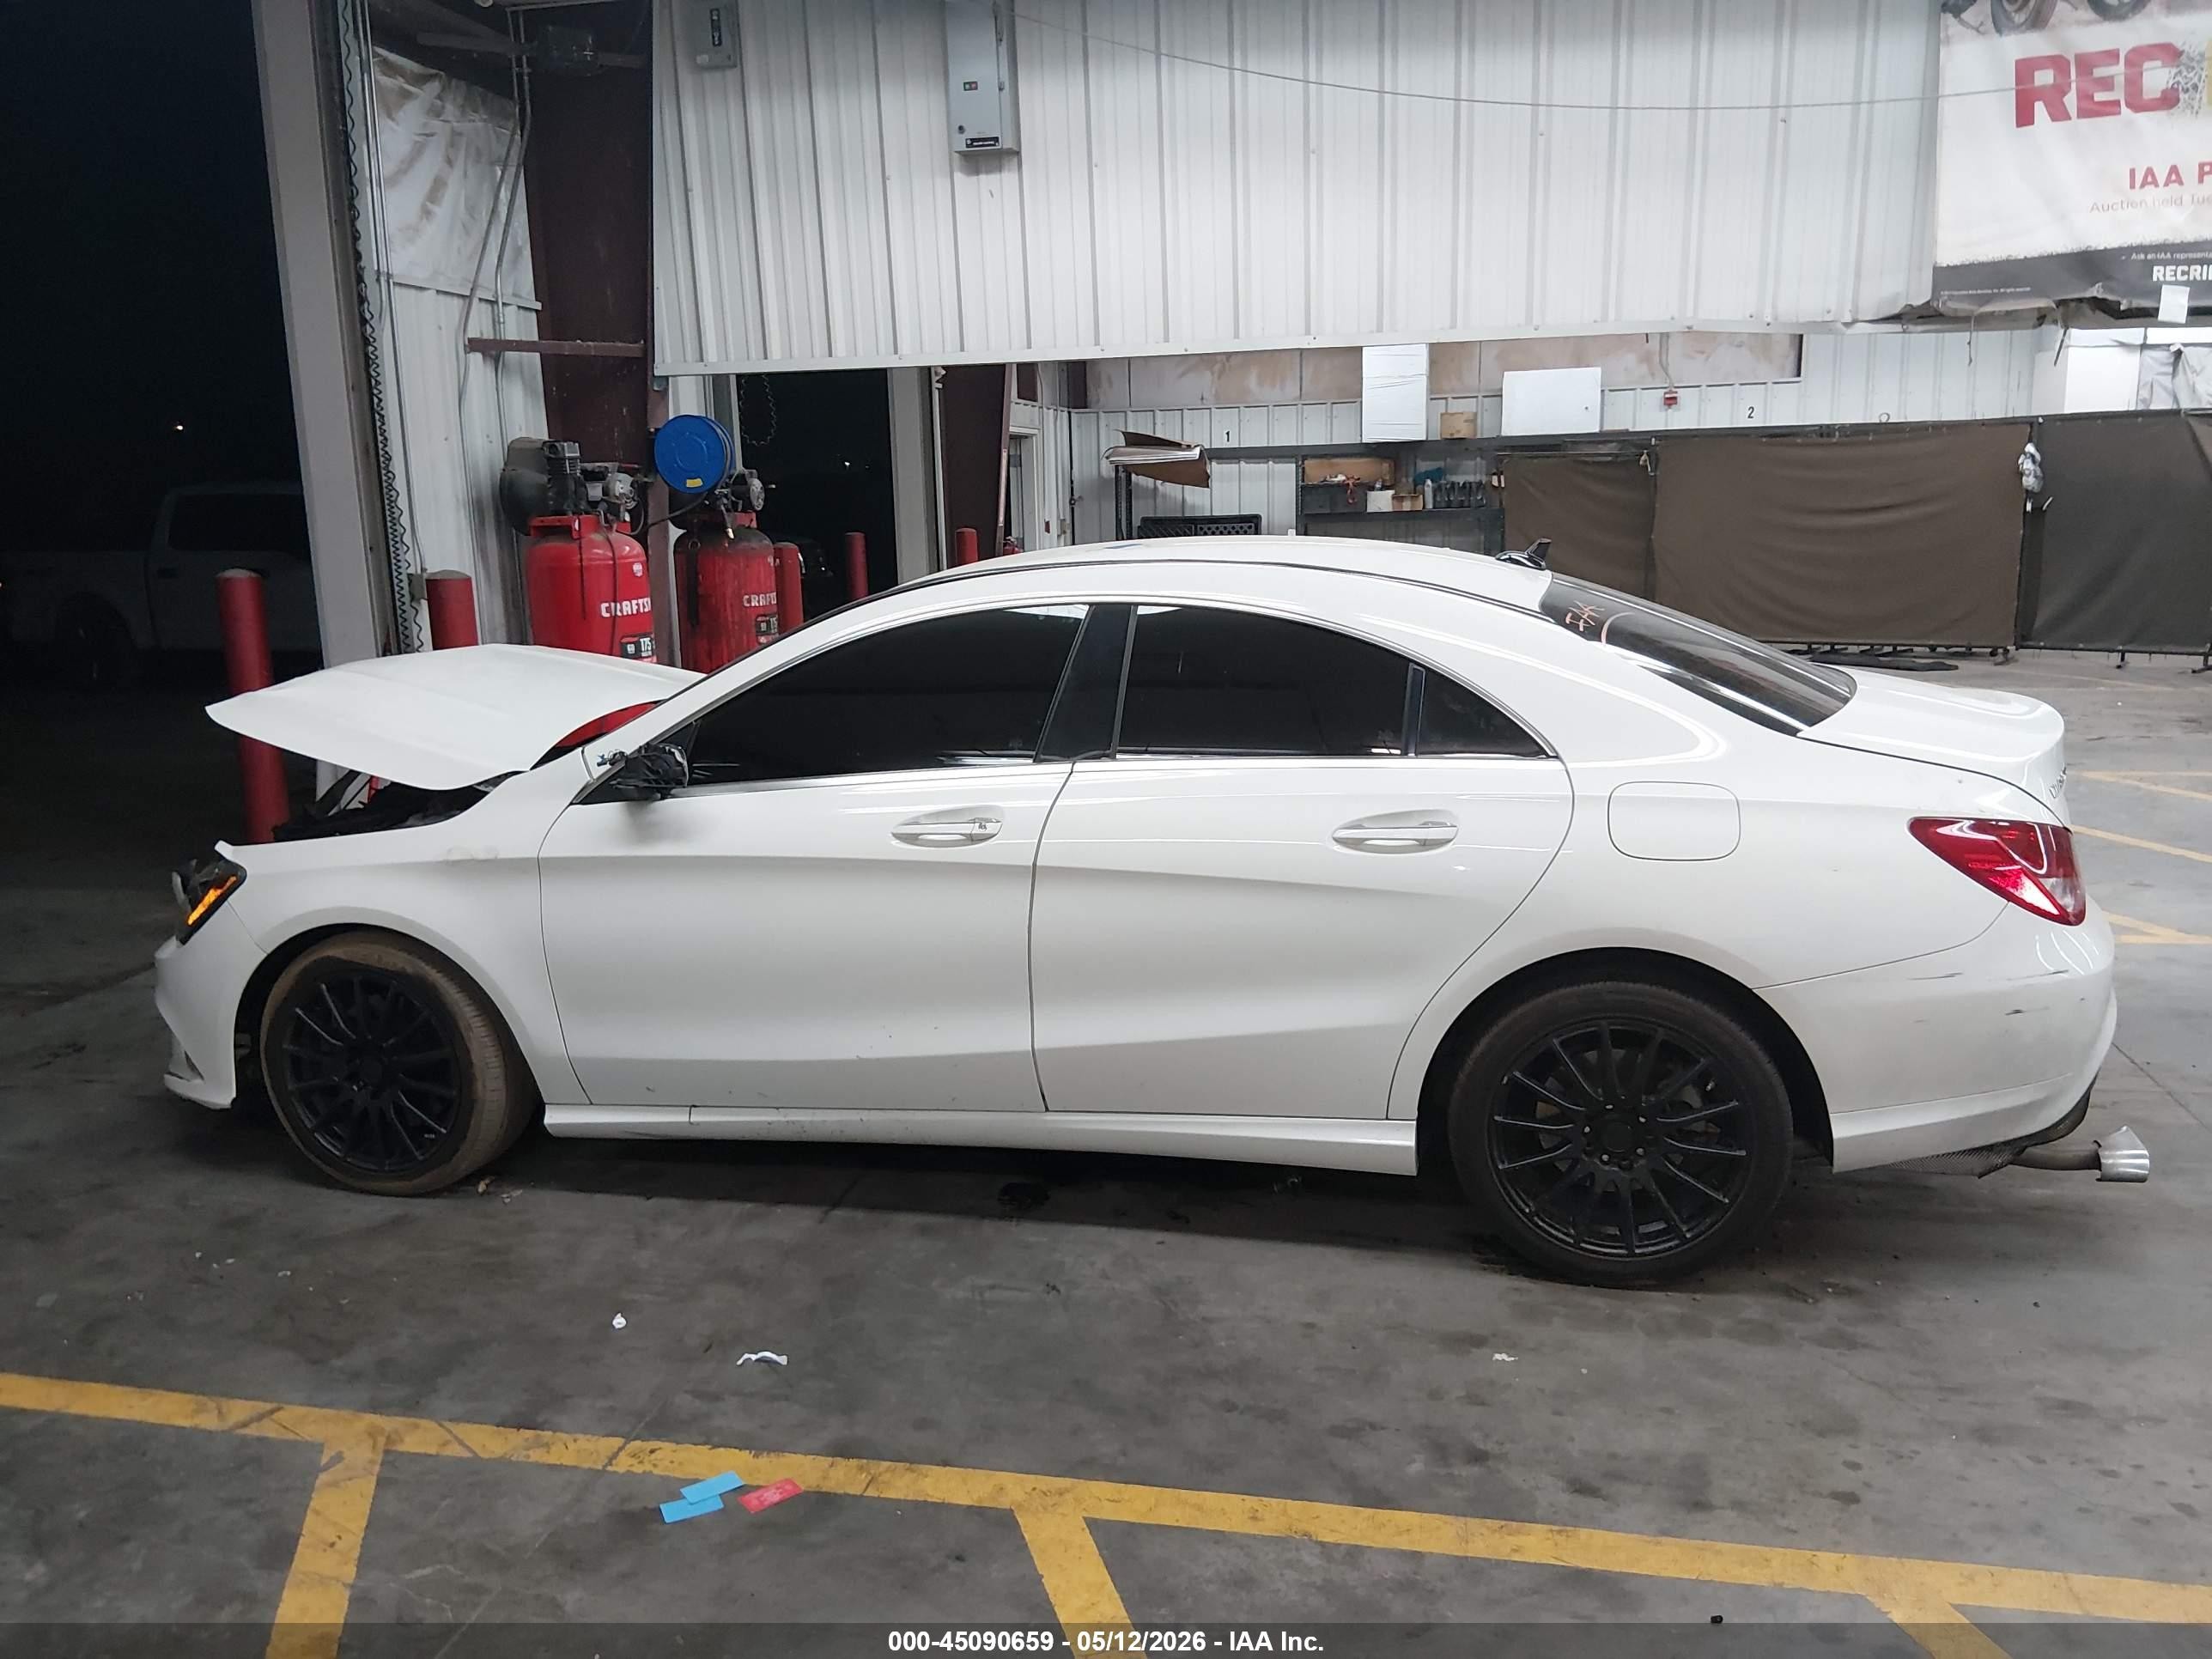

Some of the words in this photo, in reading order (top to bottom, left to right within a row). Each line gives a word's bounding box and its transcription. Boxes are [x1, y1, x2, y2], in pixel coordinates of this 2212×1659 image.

[2129, 164, 2185, 190] IAA
[2089, 198, 2148, 214] Auction
[2152, 194, 2184, 208] held
[1747, 406, 1754, 419] 2
[1225, 430, 1230, 442] 1
[600, 597, 652, 617] CRAFTS
